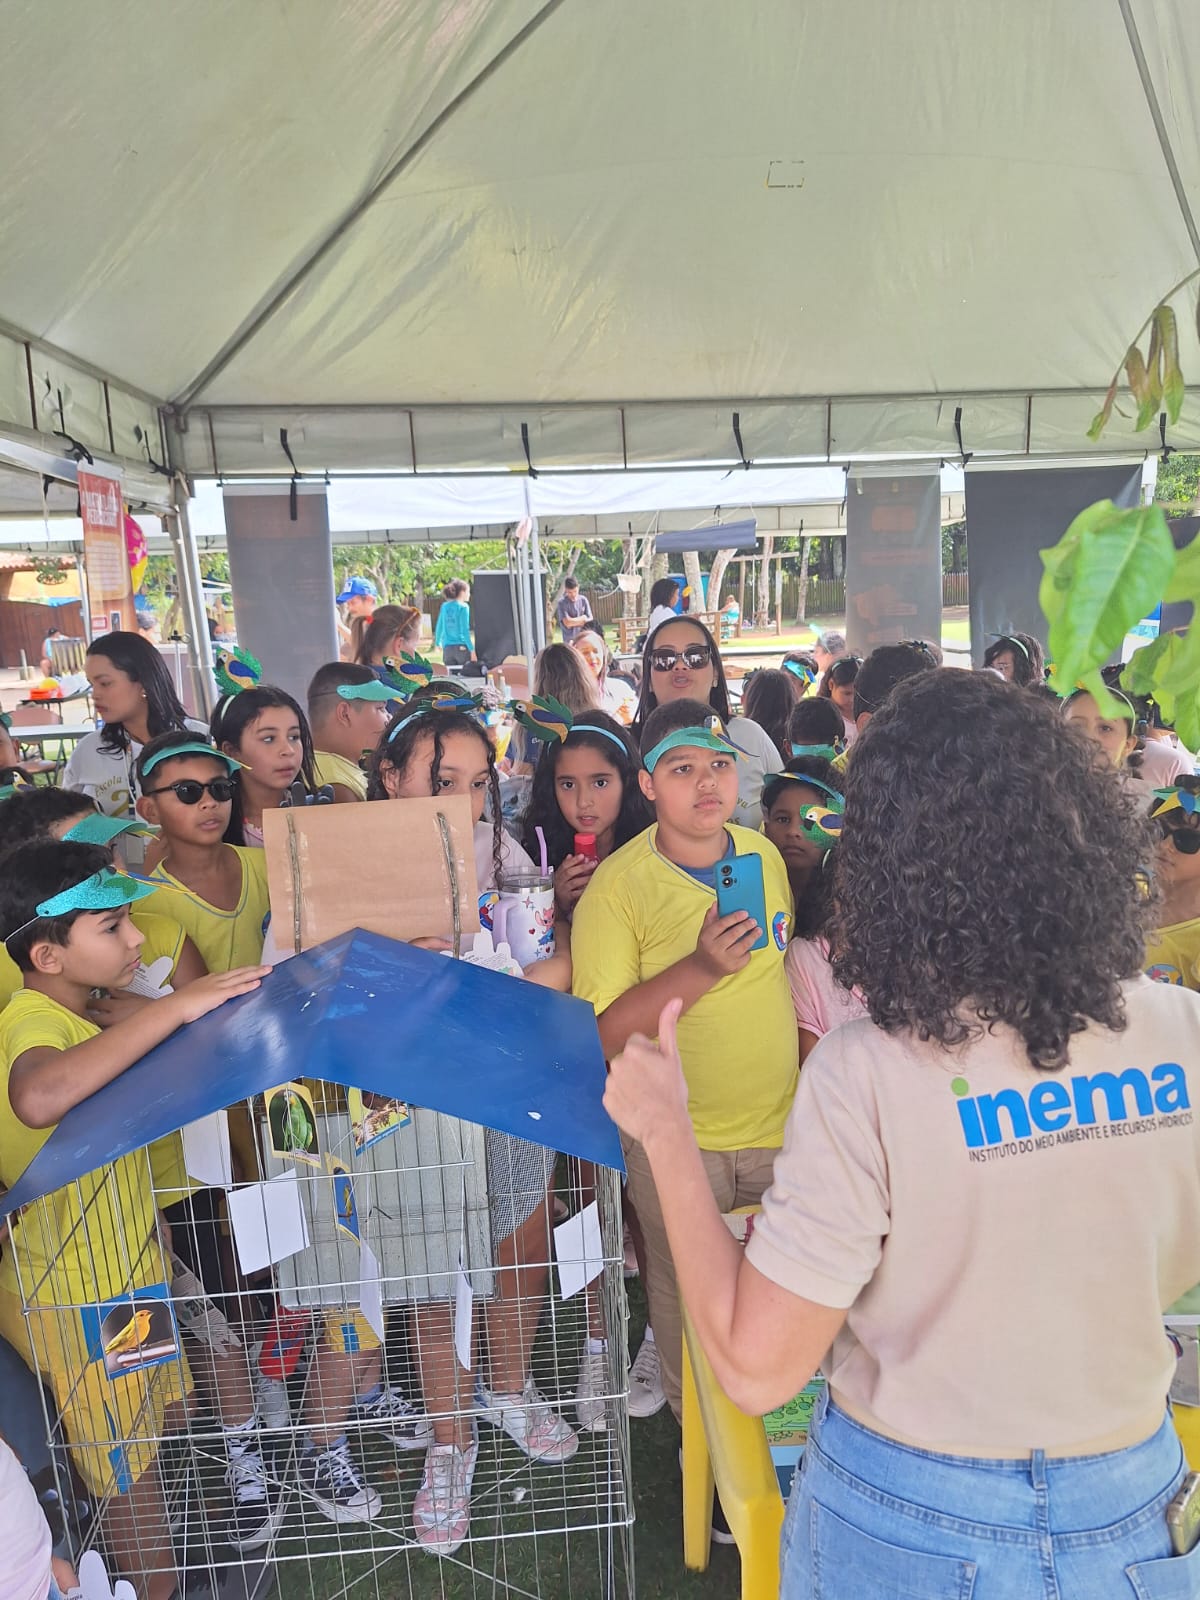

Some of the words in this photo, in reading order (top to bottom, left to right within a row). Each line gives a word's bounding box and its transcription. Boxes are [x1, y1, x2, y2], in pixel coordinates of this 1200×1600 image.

[951, 1063, 1191, 1148] inema
[969, 1142, 1017, 1162] INSTITUTO
[1019, 1139, 1034, 1154] DO
[1035, 1134, 1055, 1150] MEIO
[1056, 1126, 1102, 1145] AMBIENTE
[1103, 1125, 1110, 1138] E
[1110, 1118, 1157, 1137] RECURSOS
